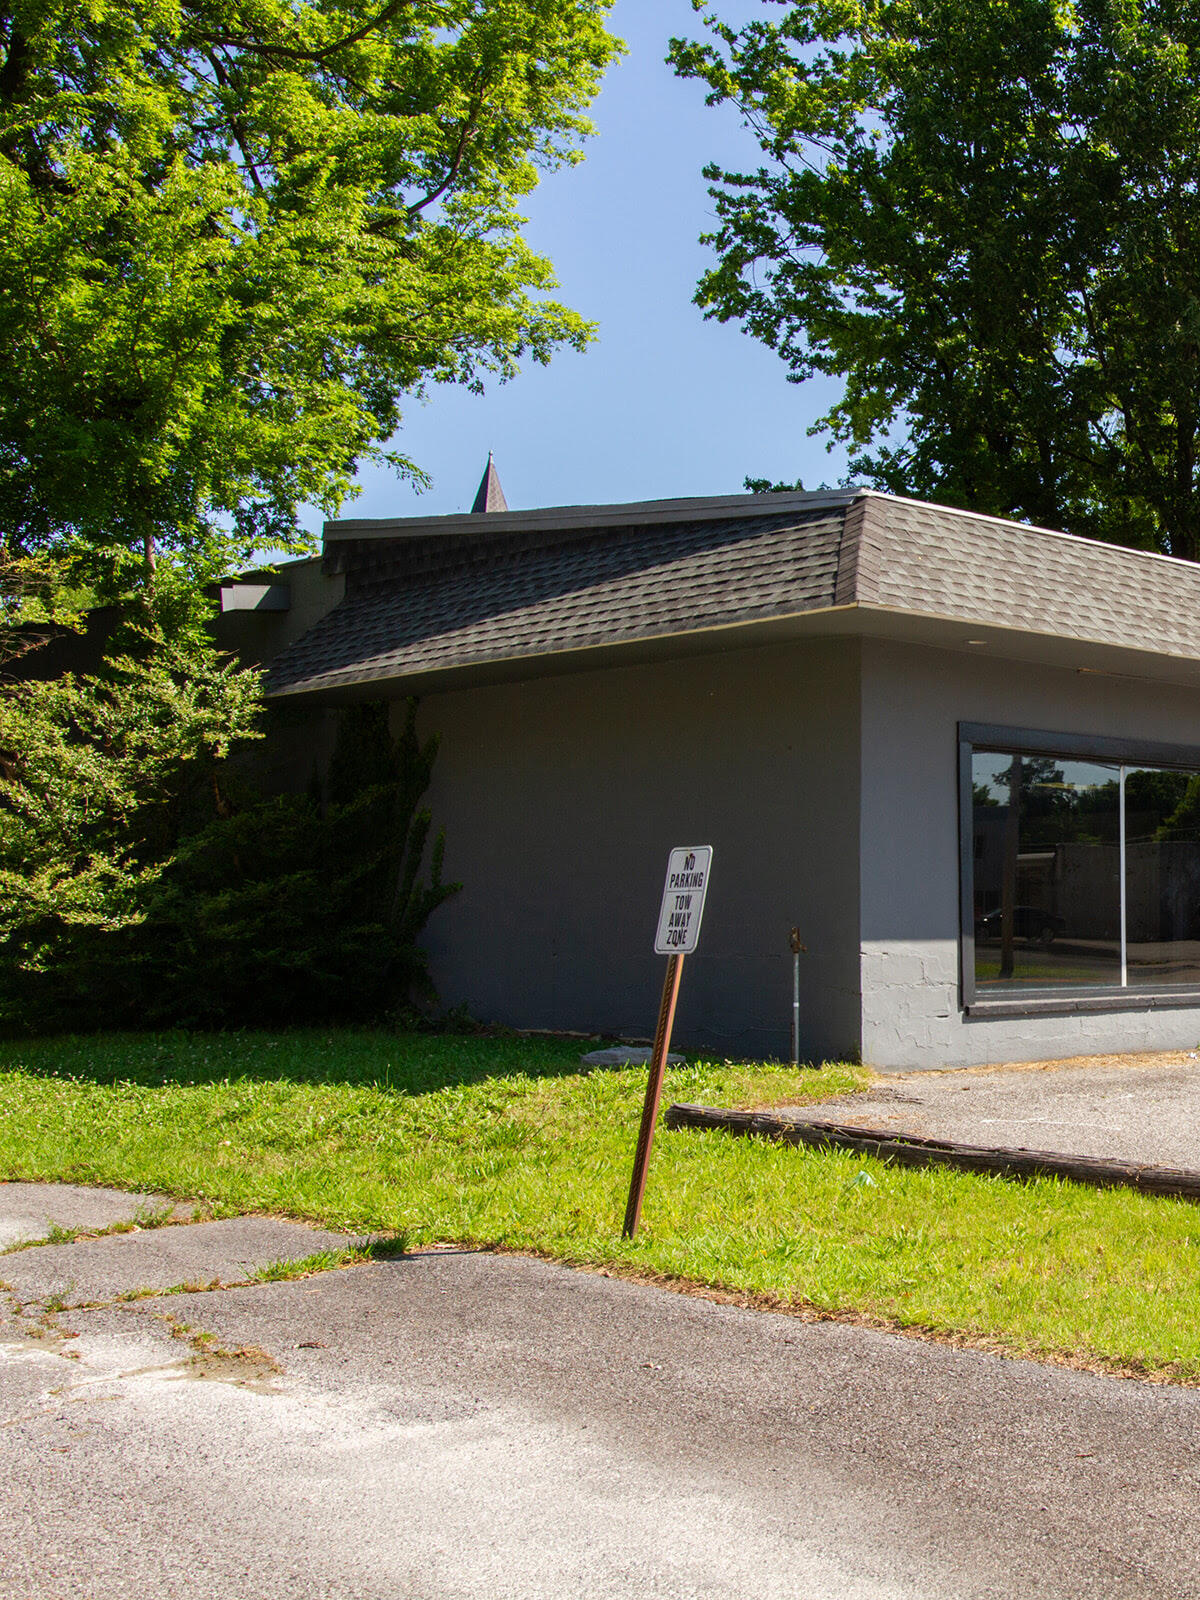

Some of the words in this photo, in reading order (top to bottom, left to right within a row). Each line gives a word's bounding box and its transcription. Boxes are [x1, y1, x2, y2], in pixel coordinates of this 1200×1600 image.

[684, 856, 696, 871] NO
[669, 872, 704, 888] PARKING
[675, 895, 693, 910] TOW
[668, 912, 692, 927] AWAY
[666, 930, 687, 945] ZONE
